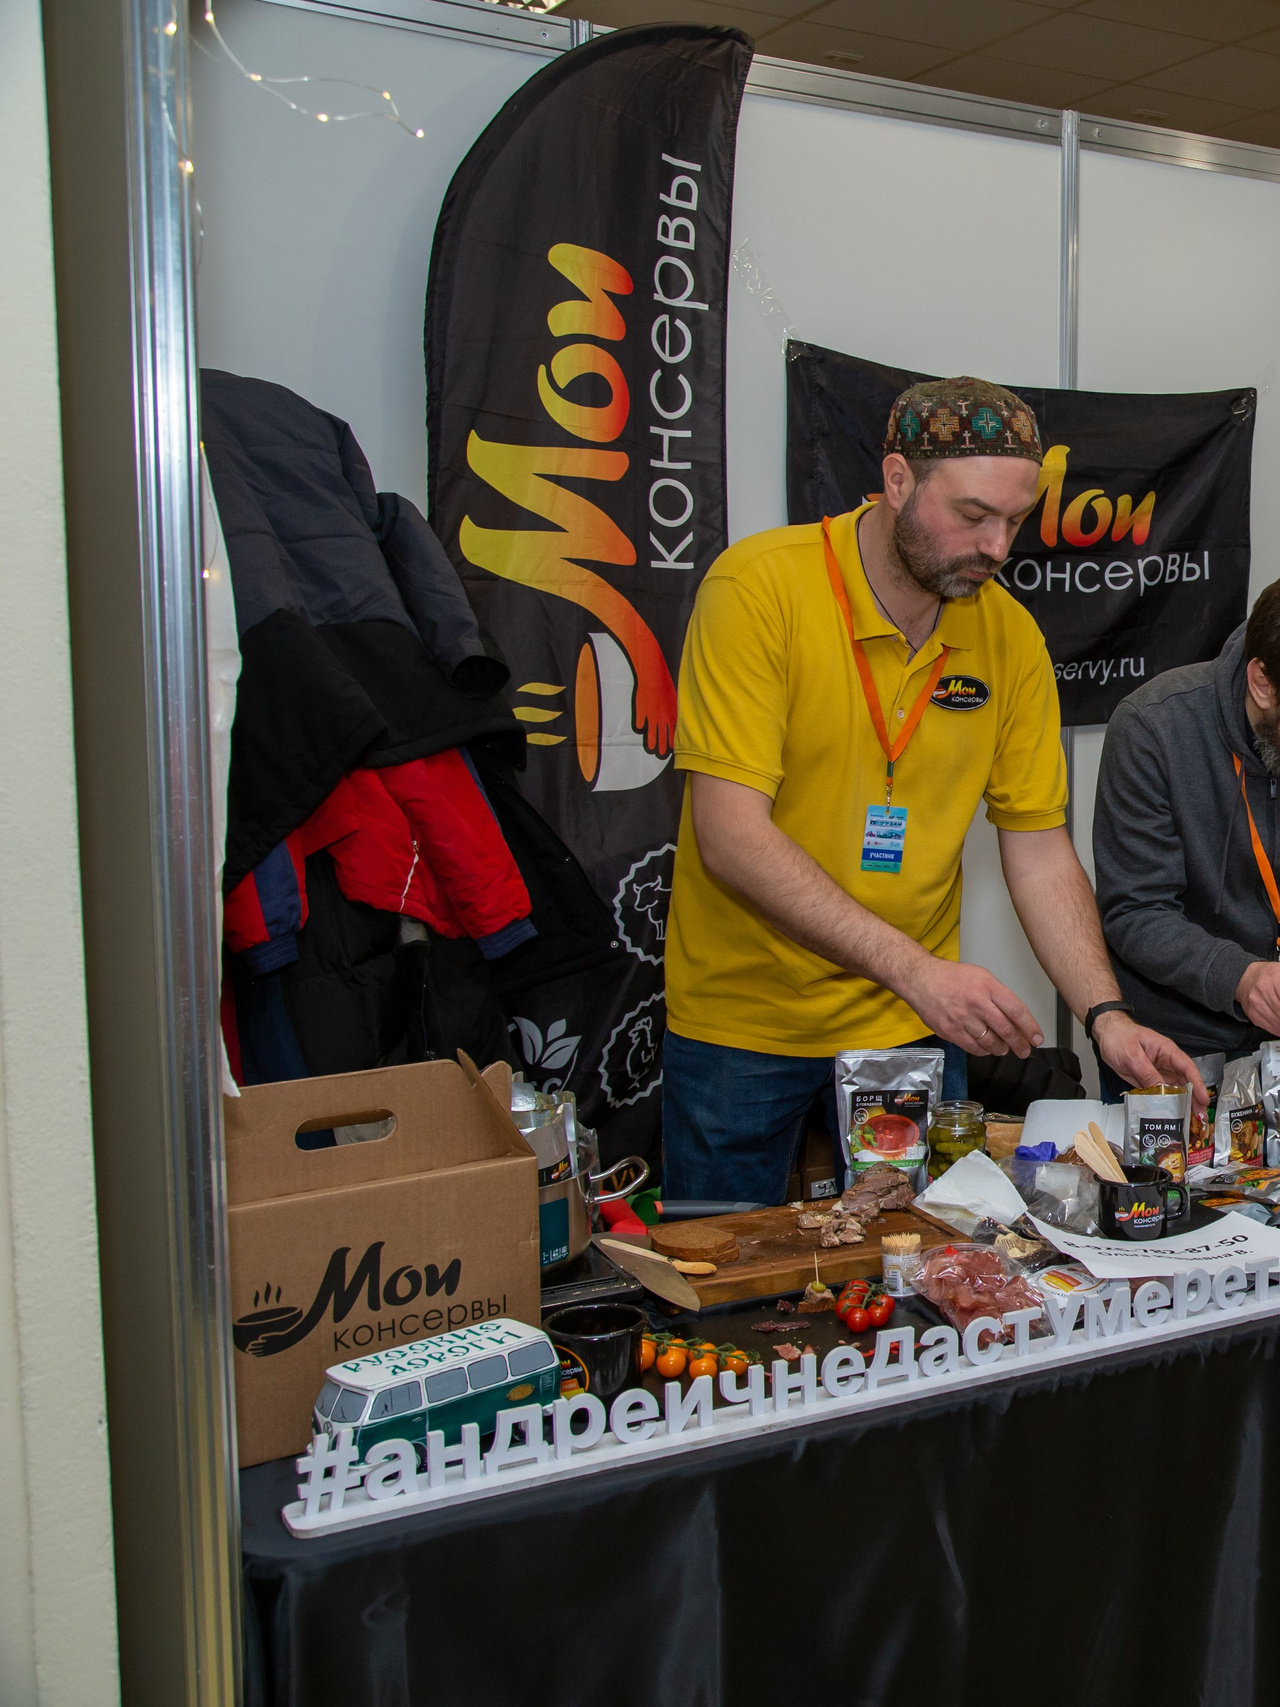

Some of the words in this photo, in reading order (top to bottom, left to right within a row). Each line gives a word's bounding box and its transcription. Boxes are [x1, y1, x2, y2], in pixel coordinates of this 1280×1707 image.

[648, 153, 709, 570] консервы
[947, 679, 976, 696] Мои
[869, 852, 895, 860] УЧАСТНИК
[856, 1095, 883, 1103] БОРЩ
[1144, 1123, 1162, 1131] ТОМ
[1129, 1202, 1160, 1219] Мои
[315, 1241, 463, 1324] Мои
[333, 1294, 508, 1352] консервы
[385, 1330, 523, 1377] ДОРОГИ
